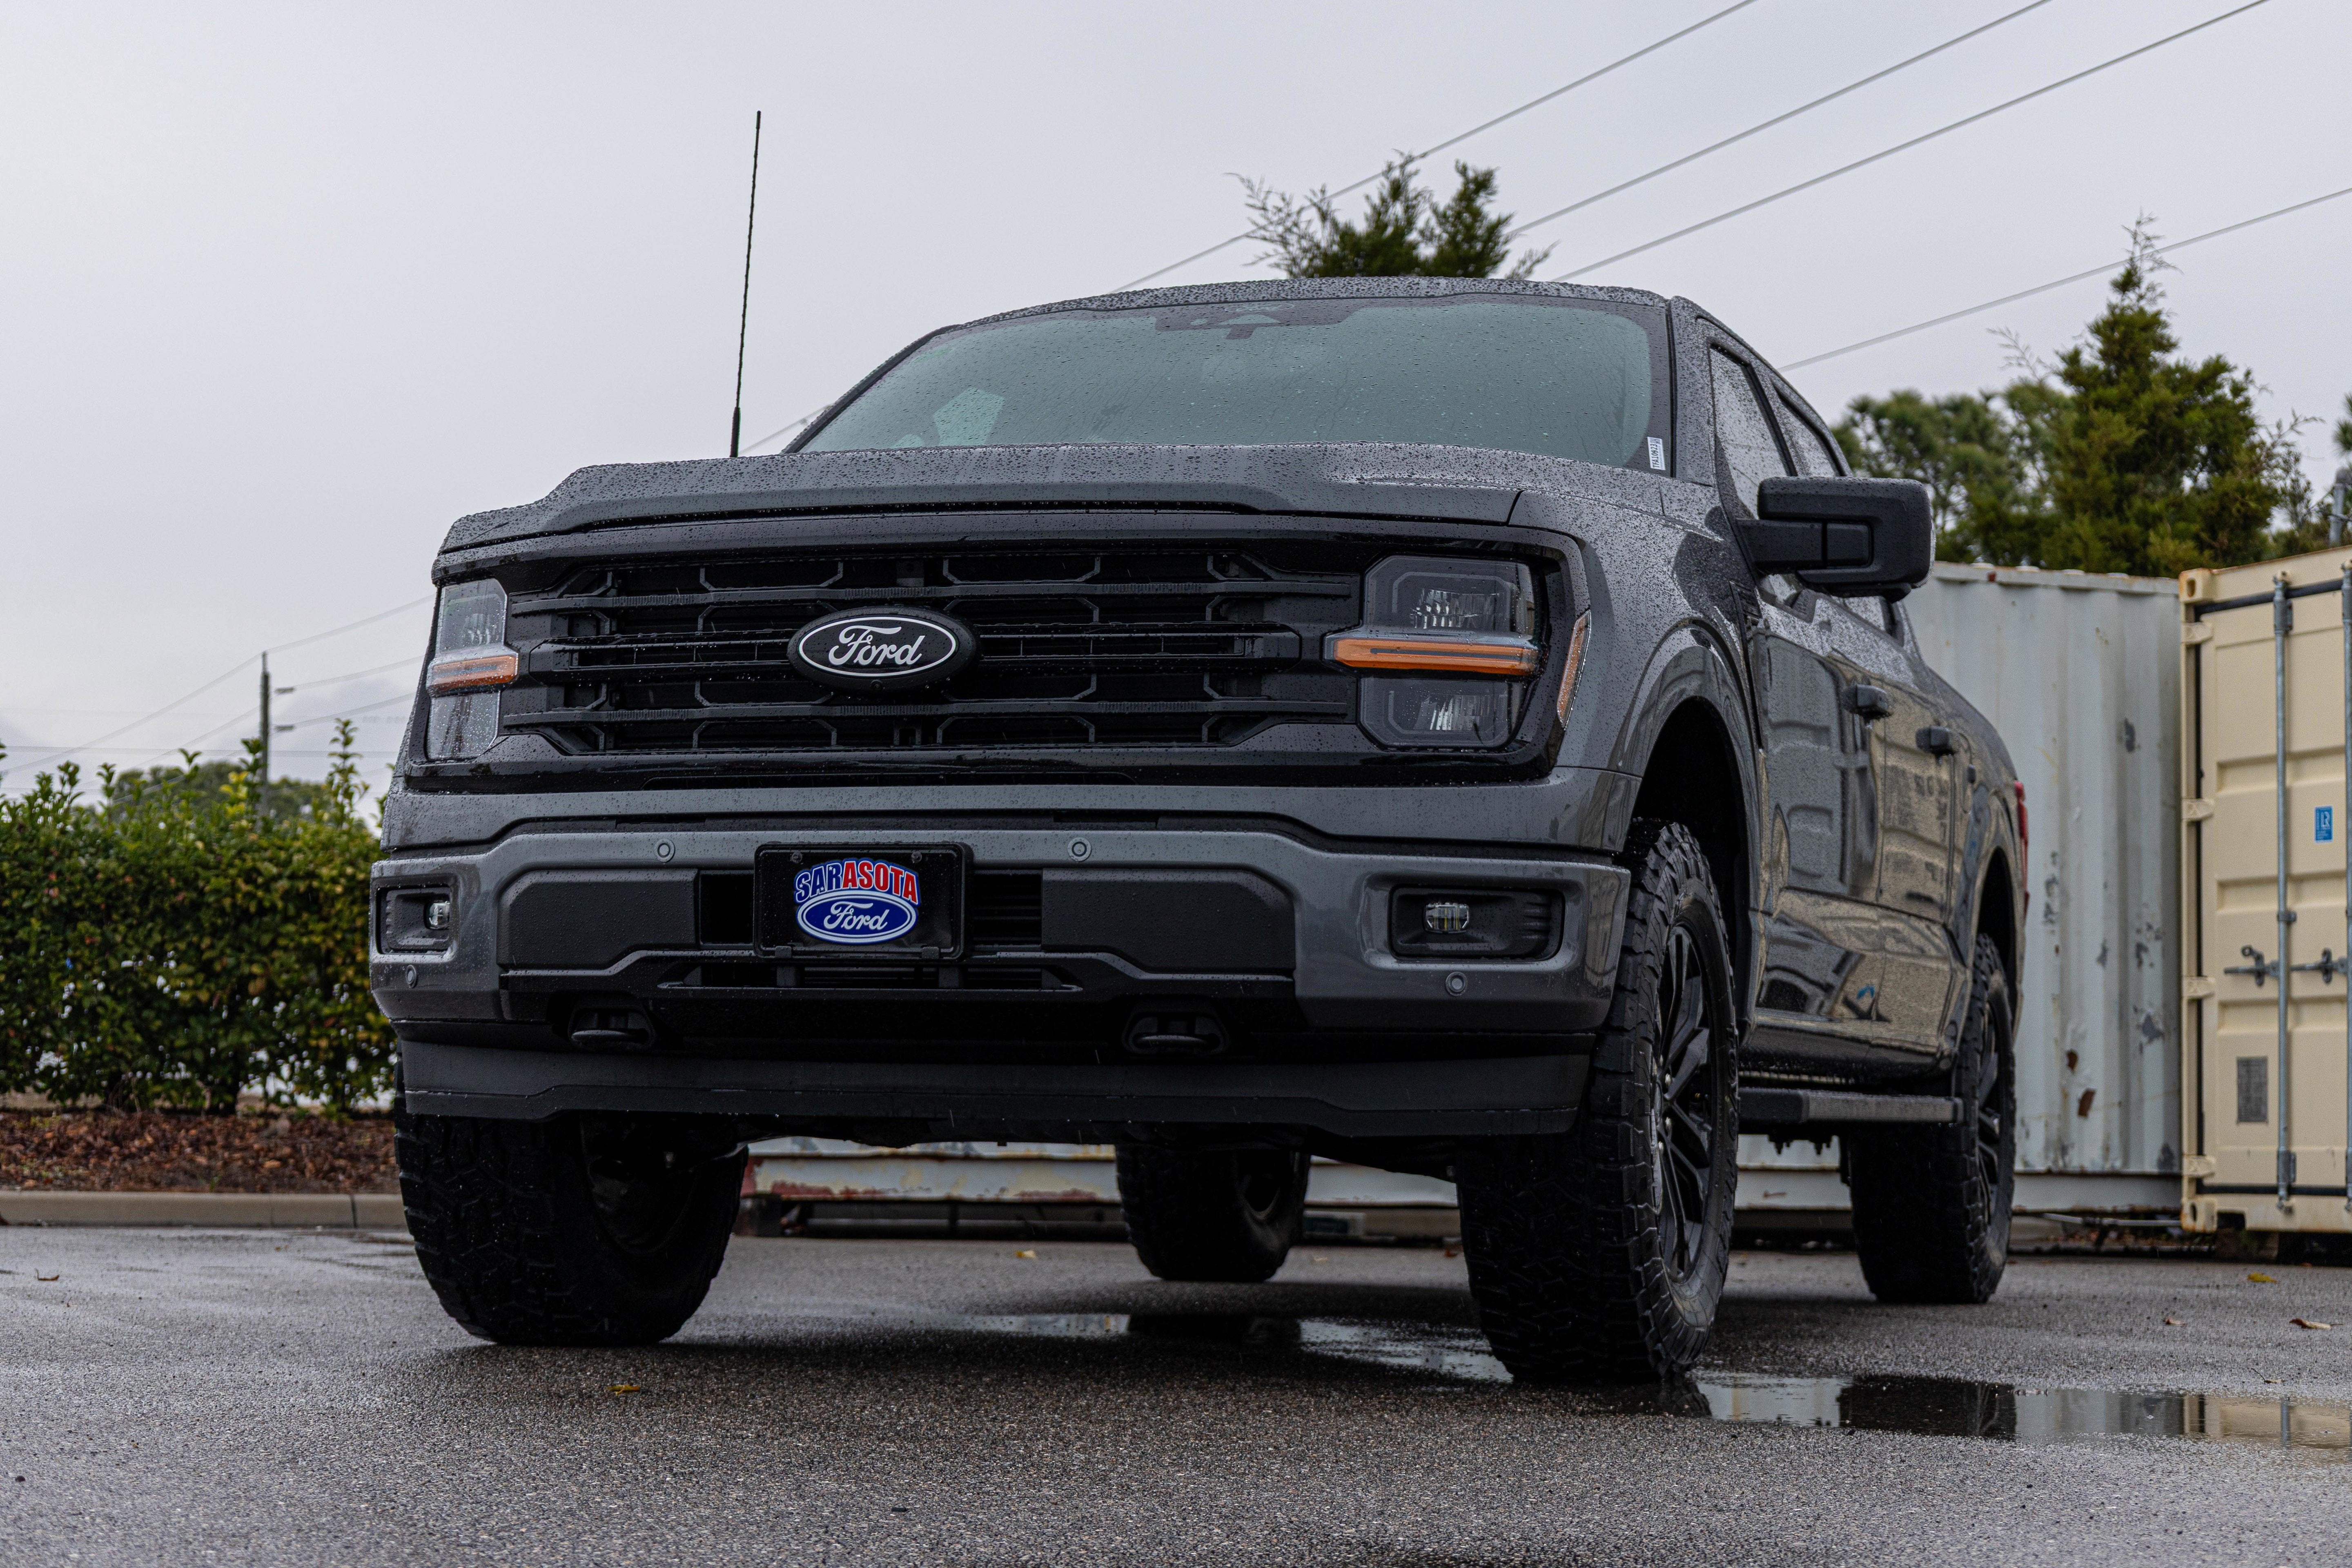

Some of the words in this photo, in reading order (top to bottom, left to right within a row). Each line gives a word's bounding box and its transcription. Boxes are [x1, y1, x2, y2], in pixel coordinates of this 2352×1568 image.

[1650, 444, 1659, 468] TFA10923
[829, 625, 925, 666] Ford
[795, 860, 919, 904] SARASOTA
[824, 901, 889, 930] Ford
